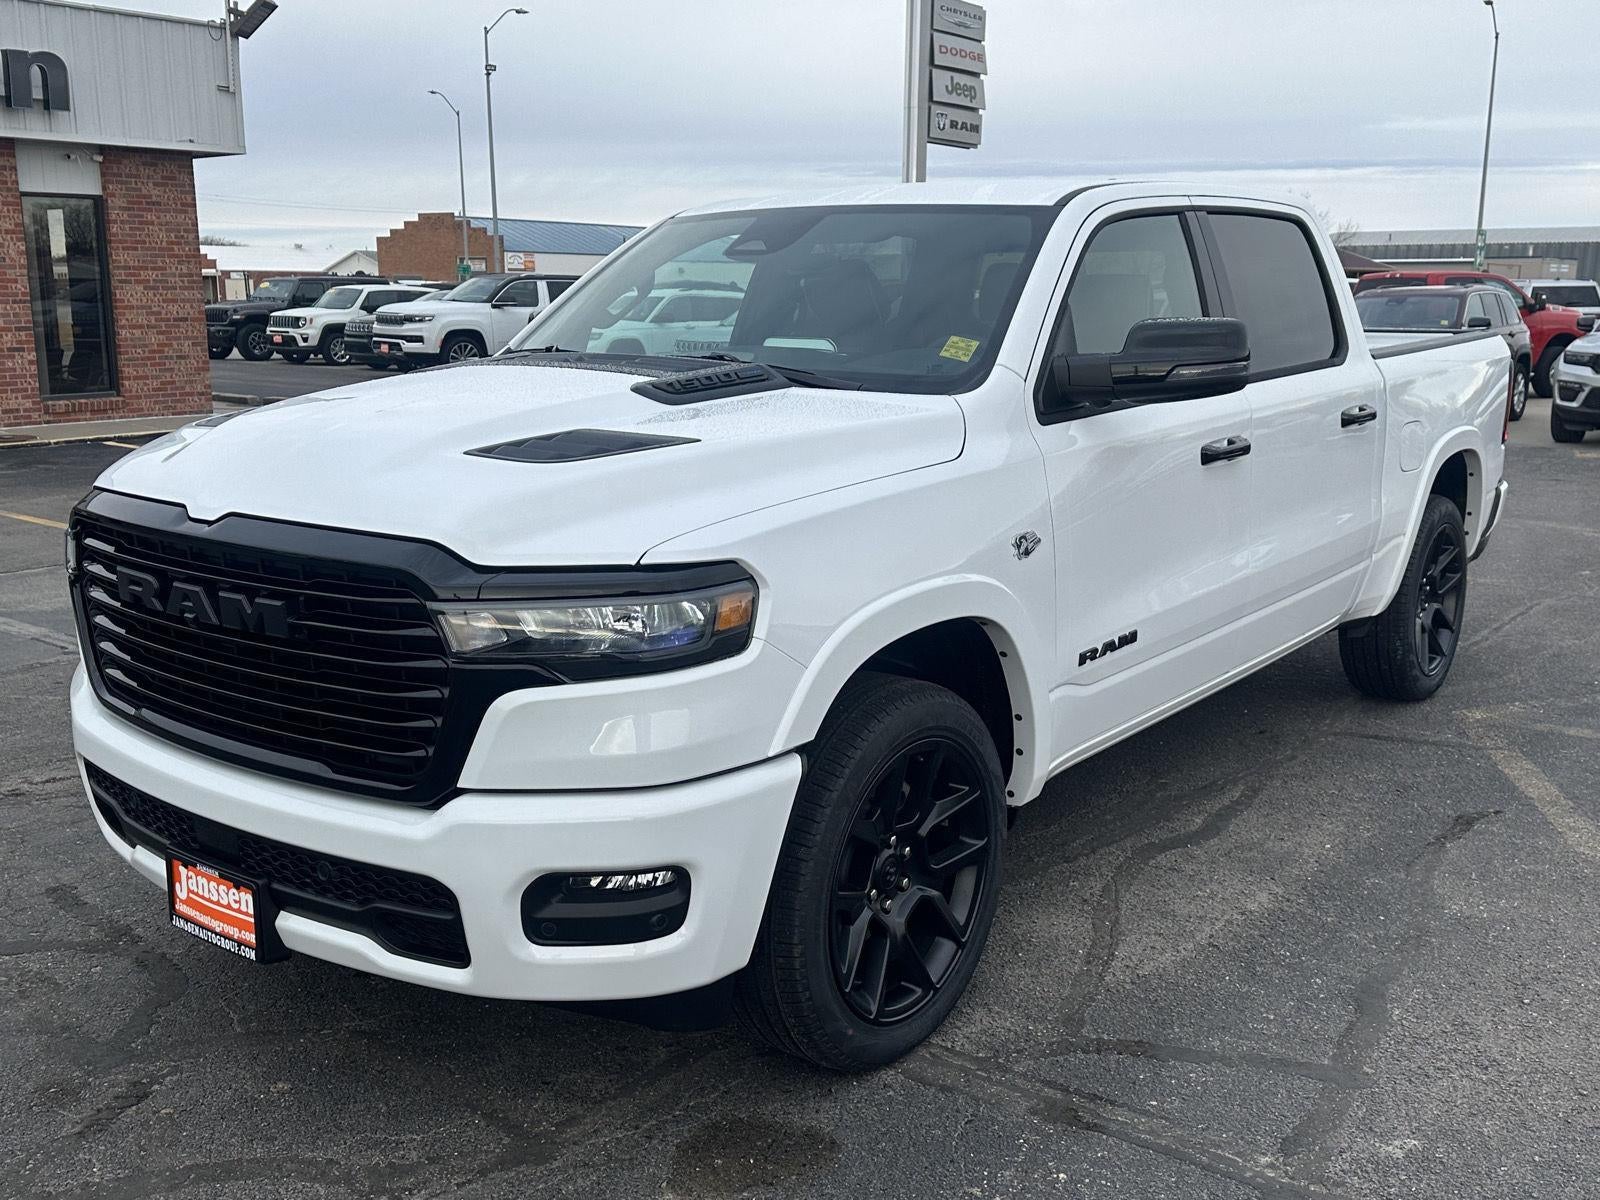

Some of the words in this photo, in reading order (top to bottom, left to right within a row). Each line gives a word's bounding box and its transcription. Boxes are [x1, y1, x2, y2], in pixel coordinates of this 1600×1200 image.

[940, 4, 983, 21] CHRYSLER
[938, 44, 984, 63] DODGE
[945, 75, 977, 103] Jeep
[949, 119, 980, 133] RAM
[667, 371, 737, 391] 1500
[117, 566, 289, 638] RAM
[1078, 629, 1138, 667] RAM
[175, 865, 255, 915] Janssen
[175, 899, 256, 943] Janssenautogroup.com
[171, 915, 257, 961] JANSSENAUTOGROUP.COM
